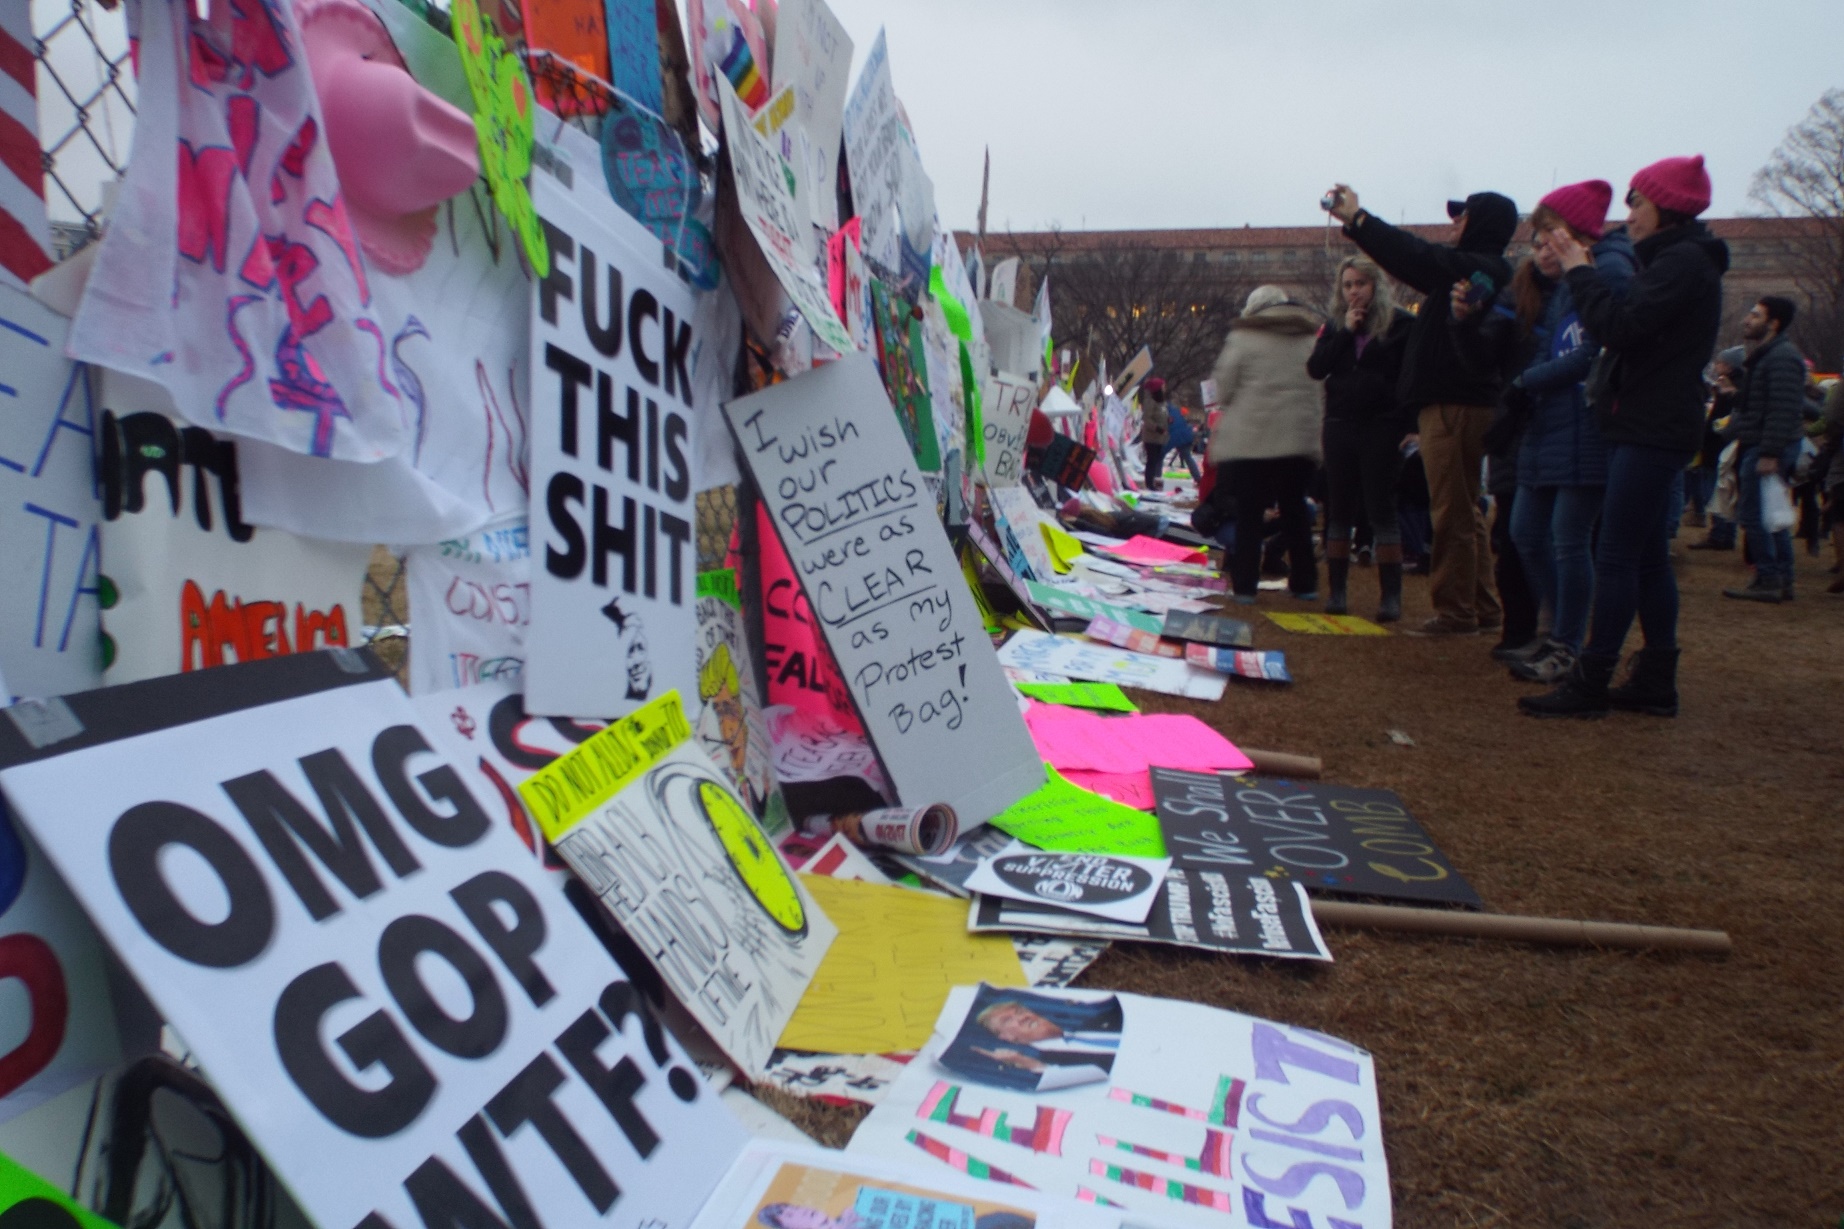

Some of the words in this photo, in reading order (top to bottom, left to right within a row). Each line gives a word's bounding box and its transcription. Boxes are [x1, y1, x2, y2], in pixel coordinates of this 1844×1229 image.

[538, 216, 693, 408] FUCK
[544, 341, 691, 504] THIS
[744, 409, 779, 453] I
[778, 417, 859, 464] wish
[778, 458, 838, 500] our
[780, 469, 917, 541] POLITICS
[545, 471, 691, 607] SHIT
[801, 535, 871, 575] were
[880, 515, 915, 543] as
[816, 549, 933, 627] CLEAR
[850, 618, 890, 649] as
[909, 590, 953, 632] my
[855, 631, 965, 707] Protest
[888, 664, 970, 734] Bag!
[559, 757, 606, 805] NOT
[1155, 768, 1231, 824] Shall
[108, 724, 492, 969] OMG
[577, 799, 673, 904] BACK
[1174, 828, 1255, 866] We
[1235, 788, 1351, 870] OVER
[1327, 798, 1450, 884] COMB
[1003, 861, 1136, 894] SUPPRESSION
[1167, 880, 1193, 924] TRUMP
[626, 871, 731, 1001] HANDS
[273, 869, 556, 1139] GOP
